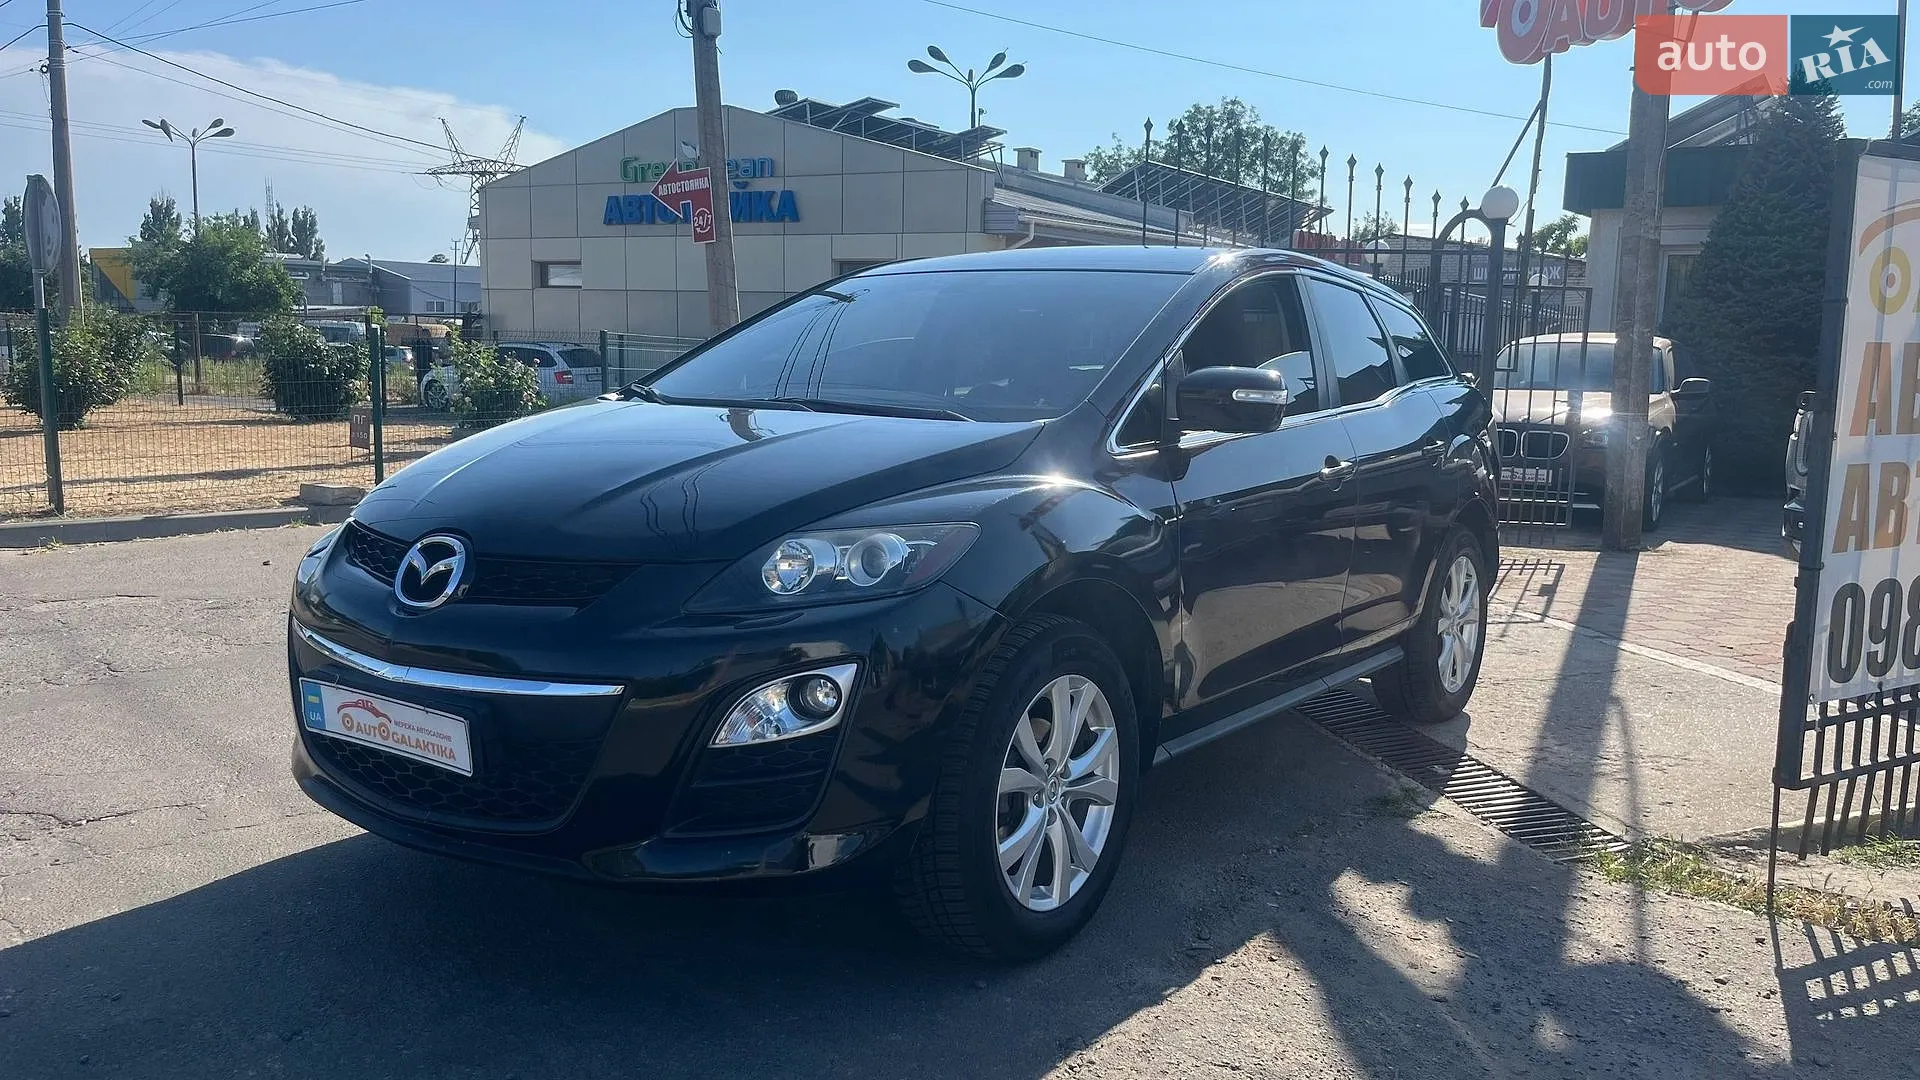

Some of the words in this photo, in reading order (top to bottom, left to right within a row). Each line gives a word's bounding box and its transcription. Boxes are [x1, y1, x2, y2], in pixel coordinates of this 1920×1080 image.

[658, 177, 710, 197] АВТОСТОЯНКА
[693, 213, 712, 228] 24/7
[309, 711, 323, 722] UA
